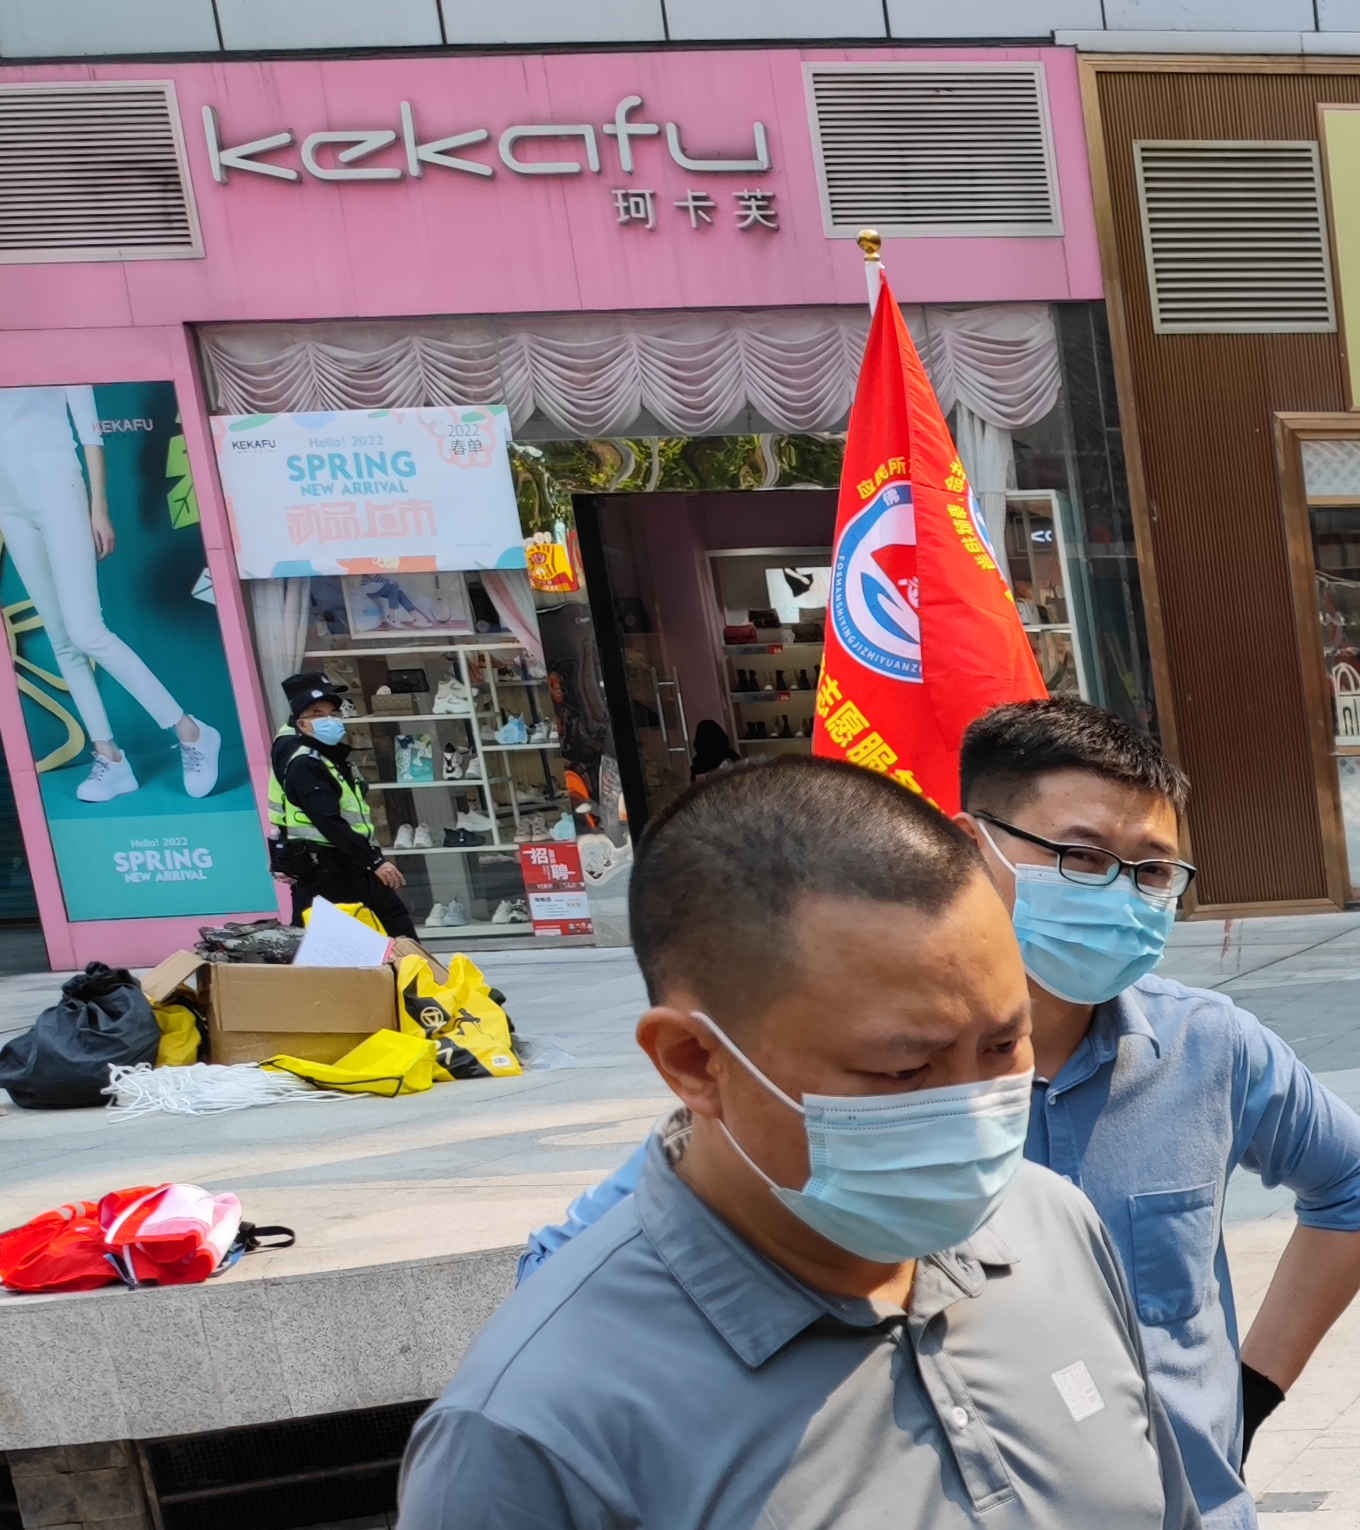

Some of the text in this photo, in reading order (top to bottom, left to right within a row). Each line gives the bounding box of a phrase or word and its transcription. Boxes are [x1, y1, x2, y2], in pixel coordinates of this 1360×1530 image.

[202, 95, 773, 183] kekafu
[611, 188, 780, 231] 珂卡芙
[231, 439, 276, 451] KEKAFU
[287, 450, 417, 483] SPRING
[300, 480, 408, 497] NEW ARRIVAL
[113, 848, 214, 873] SPRING
[124, 869, 208, 883] NEW ARRIVAL
